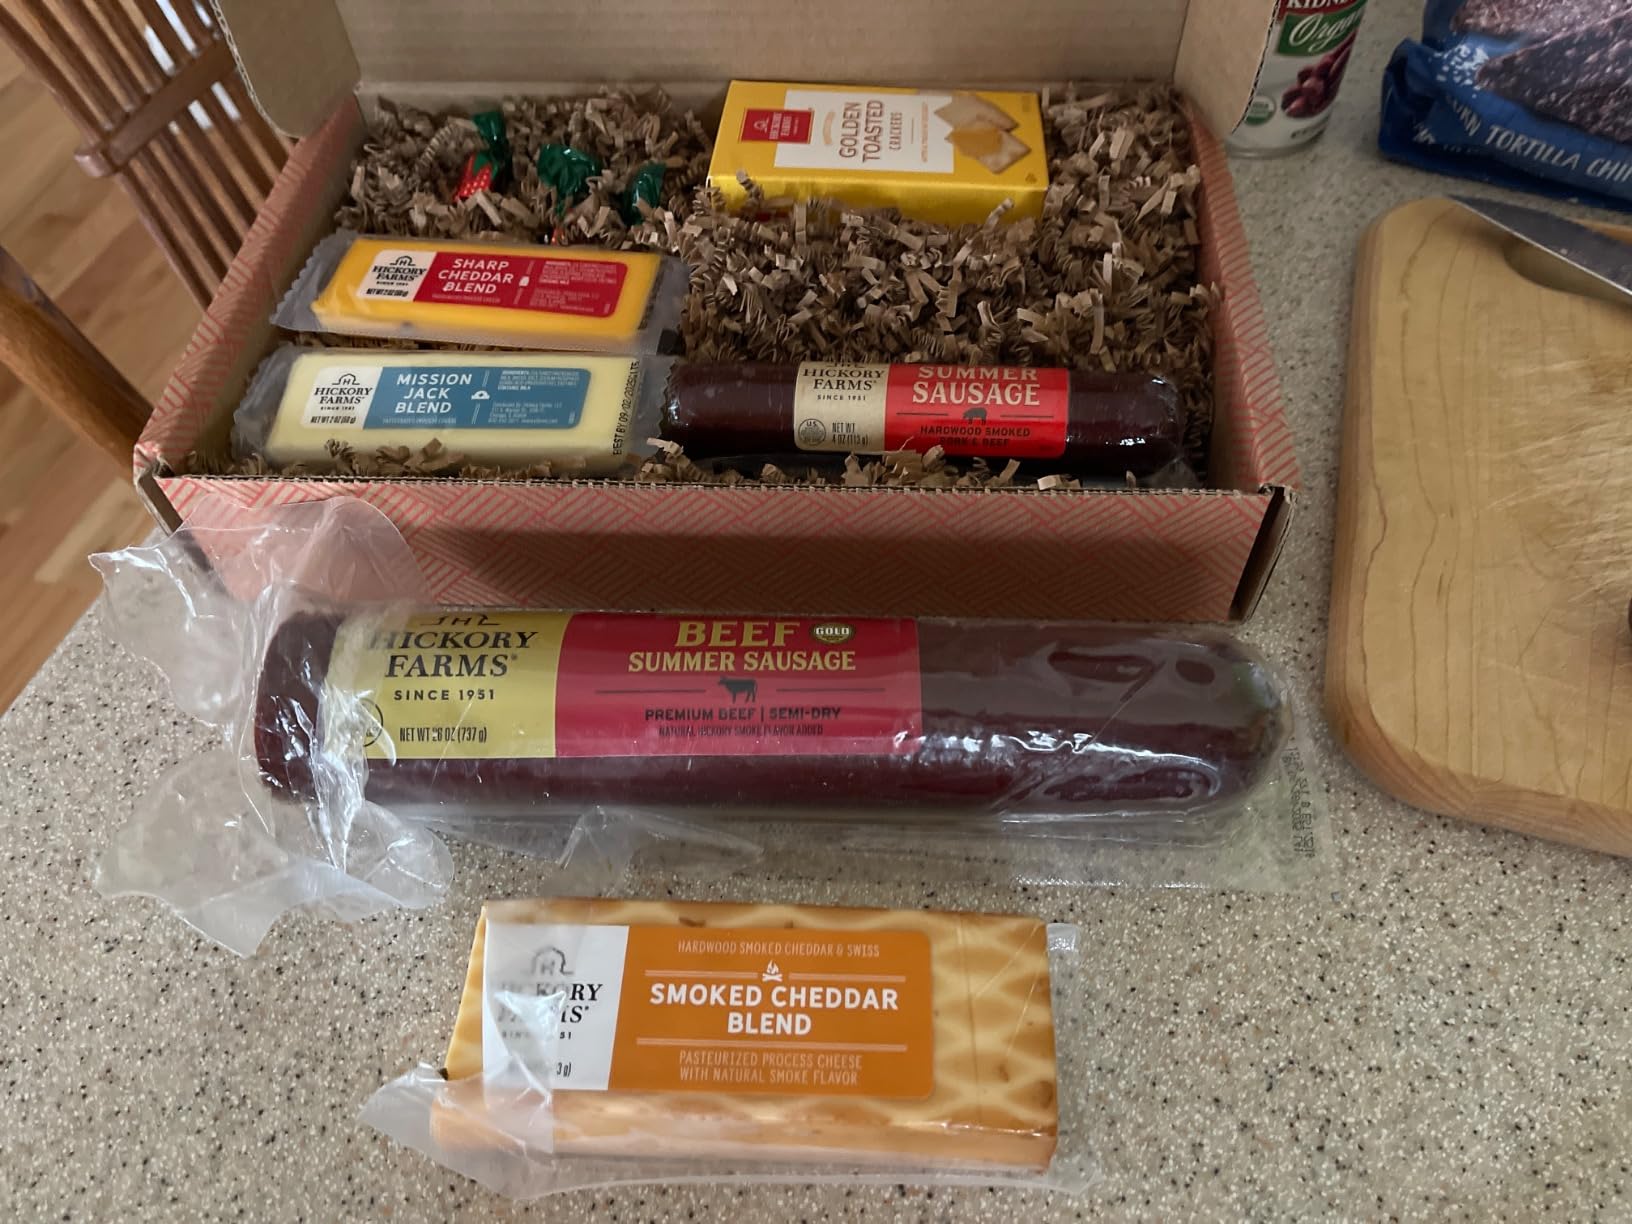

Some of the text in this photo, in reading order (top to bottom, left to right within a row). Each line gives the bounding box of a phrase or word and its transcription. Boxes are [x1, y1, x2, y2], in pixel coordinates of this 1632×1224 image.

[839, 102, 861, 158] GOLDEN
[862, 100, 884, 162] TOASTED
[1484, 125, 1582, 170] TORTILLA
[372, 265, 427, 275] HICKORY
[452, 258, 509, 270] SHARP
[376, 273, 415, 282] FARMS
[438, 270, 514, 284] CHEDDAR
[442, 282, 497, 294] BLEND
[397, 373, 473, 386] MISSION
[803, 368, 885, 379] HICKORY
[918, 366, 1038, 380] SUMMER
[314, 387, 373, 396] HICKORY
[813, 379, 873, 391] FARMS
[319, 396, 361, 404] FARMS
[404, 388, 450, 400] JACK
[912, 381, 1041, 406] SAUSAGE
[395, 402, 452, 414] BLEND
[832, 422, 844, 434] NET
[845, 422, 855, 433] WT
[920, 425, 1031, 437] HARDWOOD SMOKED
[370, 631, 539, 650] HICKORY
[674, 621, 850, 648] BEEF GOLD
[385, 654, 509, 678] FARMS
[628, 650, 857, 672] SUMMER SAUSAGE
[394, 688, 495, 701] SINCE 1951
[645, 706, 841, 721] PREMIUM BEEF SEMI-DRY
[400, 728, 416, 743] NET
[417, 728, 431, 742] WT
[445, 727, 455, 742] OZ
[457, 727, 477, 743] (737
[479, 727, 487, 743] g)
[659, 725, 695, 736] NATURAL
[795, 724, 823, 735] ADDED
[678, 940, 880, 957] HARDWOOD SMOKED CHEDDAR & SWISS
[650, 983, 899, 1011] SMOKED CHEDDAR
[727, 1012, 813, 1036] BLEND
[679, 1051, 862, 1069] PASTEURIZED PROCESS CHEESE
[679, 1067, 858, 1086] WITH NATURAL SMOKE FLAVOR
